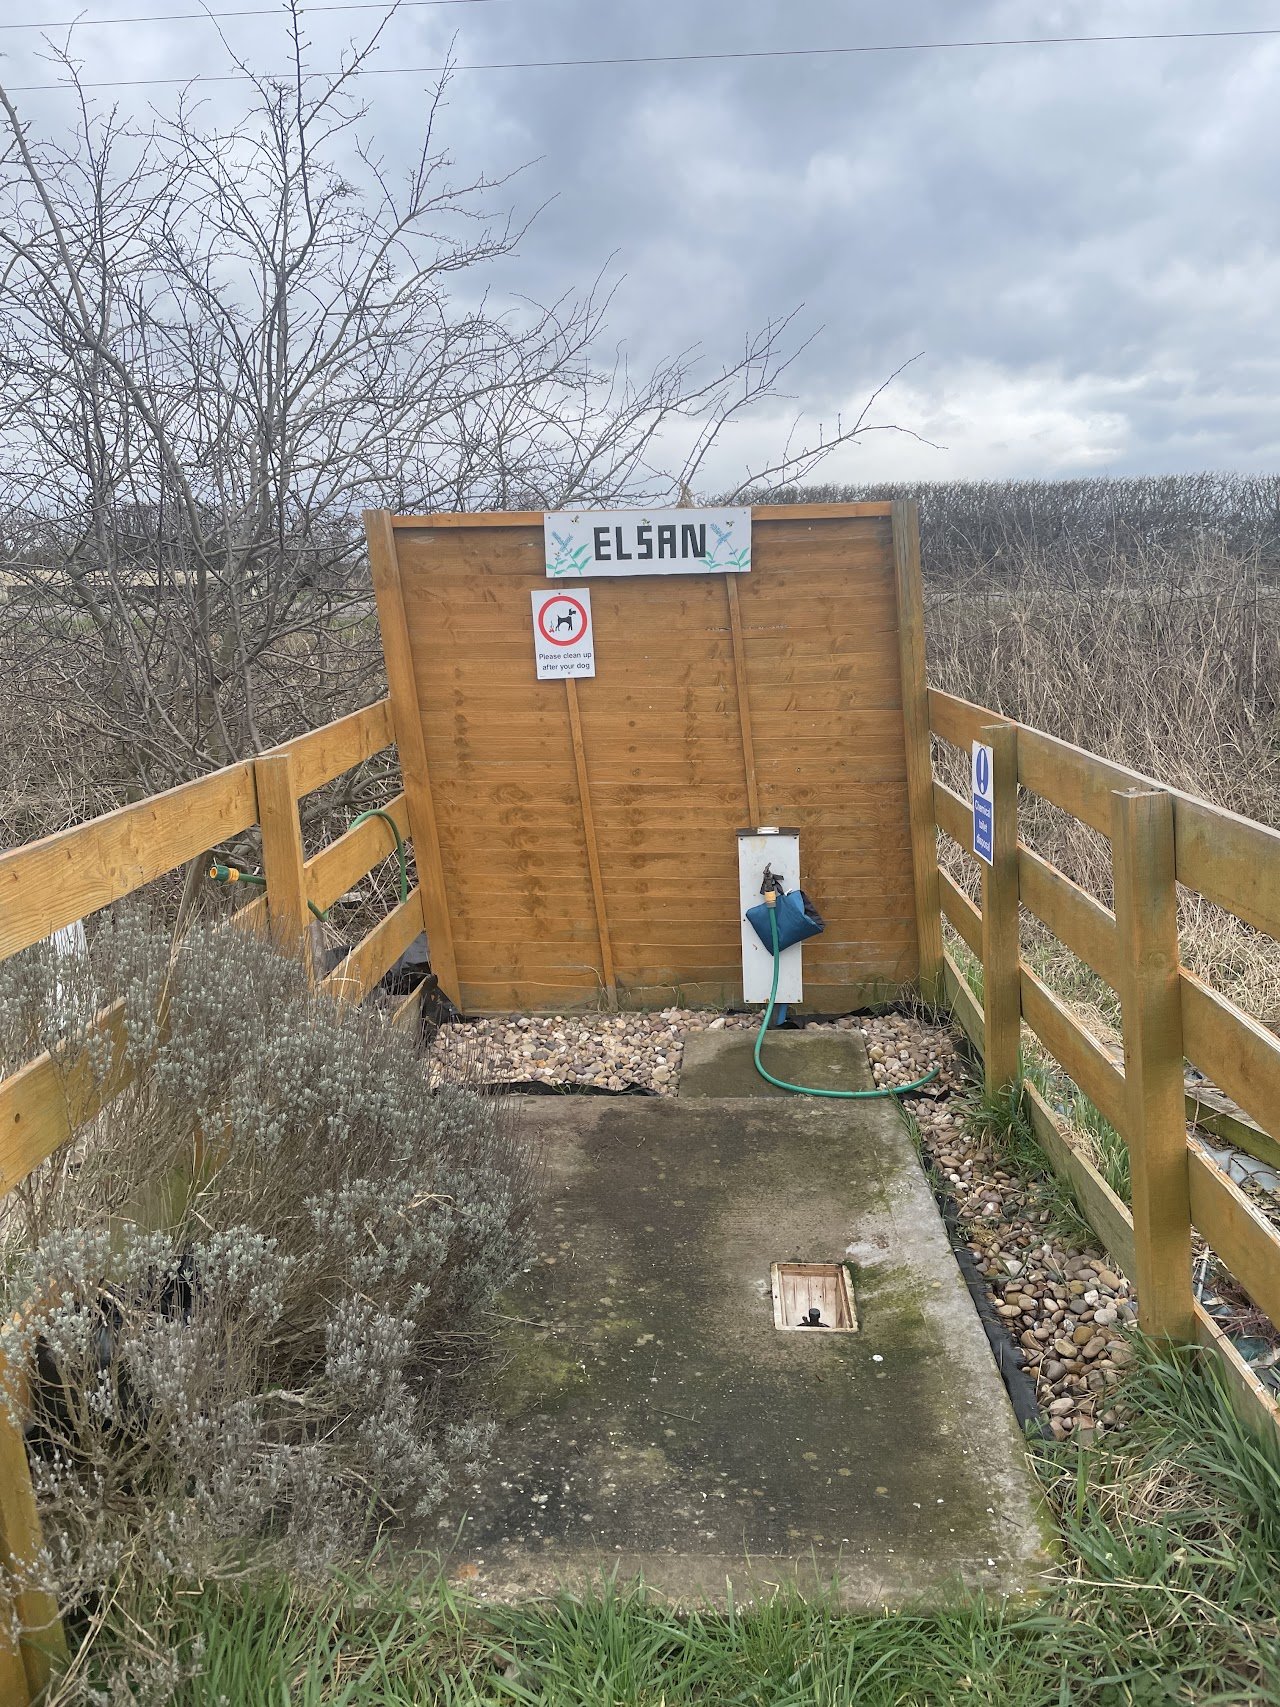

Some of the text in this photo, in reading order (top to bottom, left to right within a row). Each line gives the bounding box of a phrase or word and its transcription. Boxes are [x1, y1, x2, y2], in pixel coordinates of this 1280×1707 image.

[594, 524, 706, 560] ELSAN
[975, 800, 991, 818] Chemical
[978, 819, 988, 833] toilet
[976, 834, 991, 853] disposal
